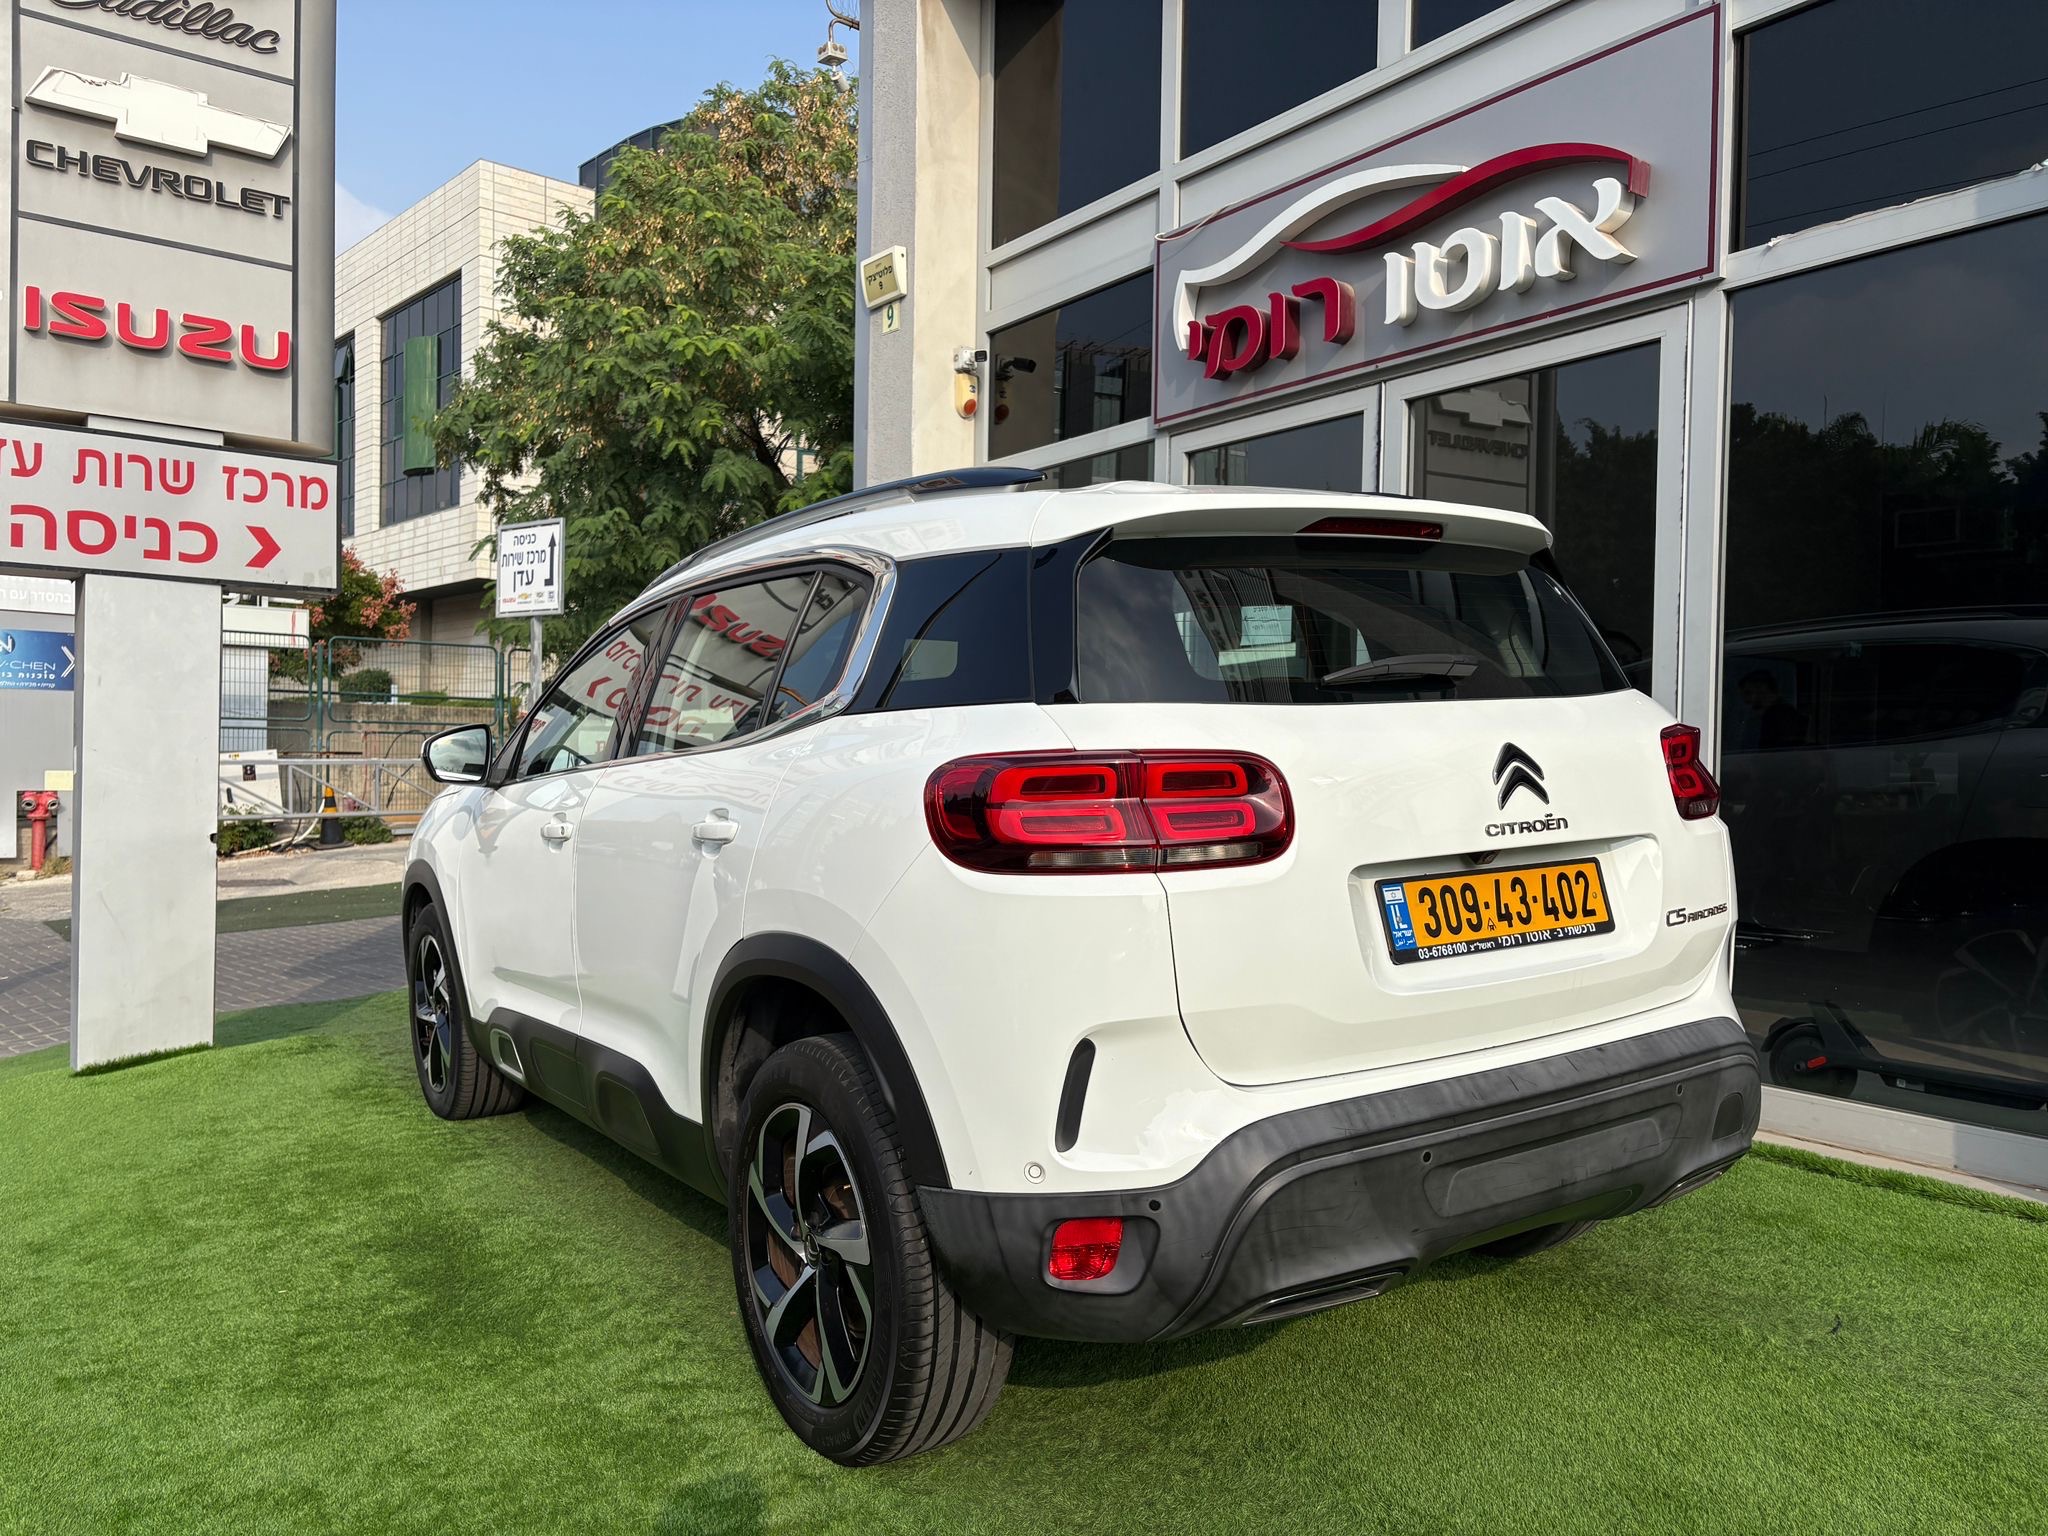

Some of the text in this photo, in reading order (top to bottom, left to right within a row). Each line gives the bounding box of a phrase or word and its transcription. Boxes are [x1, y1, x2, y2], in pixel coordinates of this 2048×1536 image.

[25, 139, 290, 218] CHEVROLET
[1188, 177, 1638, 380] אוטו רומי
[24, 285, 291, 370] ISUZU
[887, 304, 894, 329] 9
[72, 448, 195, 495] שרות
[222, 465, 328, 510] מרכז
[10, 504, 218, 564] כניסה
[513, 533, 536, 546] כניסה
[502, 549, 546, 567] מרכז שירות
[513, 569, 534, 593] עדן
[1390, 904, 1408, 929] IL
[1687, 902, 1727, 922] AIRCROSS
[1498, 934, 1522, 947] רומי
[1526, 930, 1551, 943] אוטו
[1565, 923, 1596, 935] נרכשתי
[1418, 942, 1467, 959] 03-6768100
